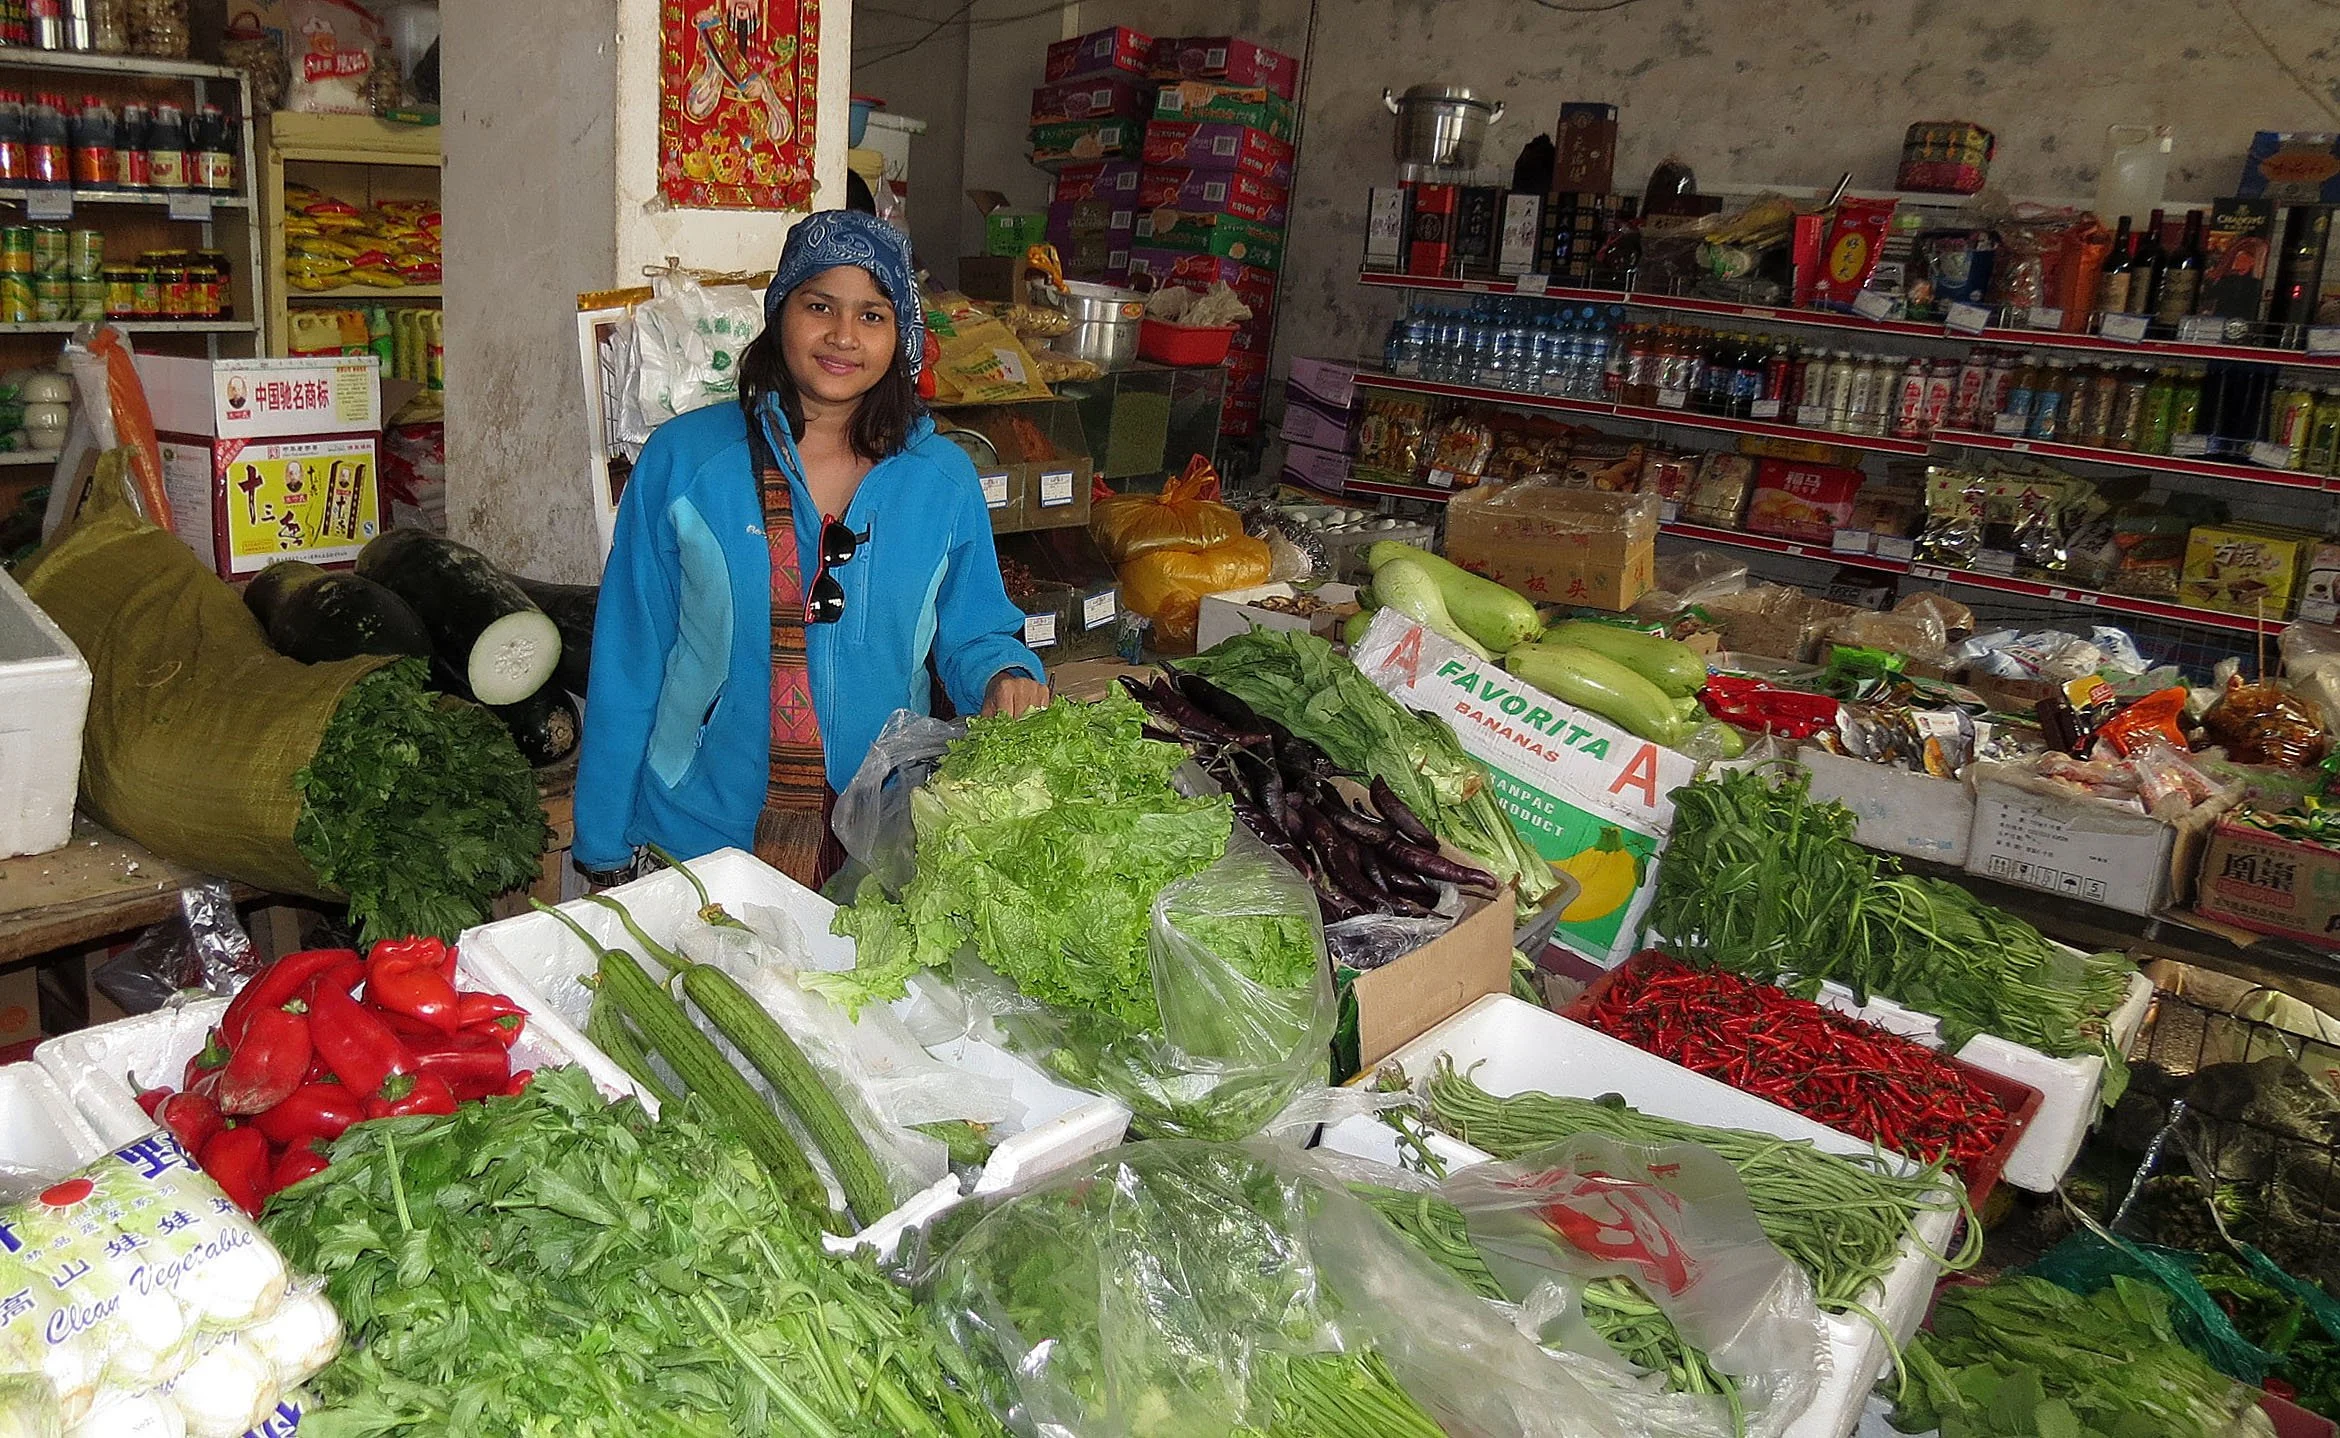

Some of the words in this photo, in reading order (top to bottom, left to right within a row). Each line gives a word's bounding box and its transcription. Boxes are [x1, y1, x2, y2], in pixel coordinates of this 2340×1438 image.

[255, 378, 330, 412] 中国驰名商标
[1381, 625, 1423, 689] A
[1436, 660, 1611, 761] FAVORITA
[1454, 701, 1560, 763] BANANAS
[1608, 744, 1658, 808] A
[1499, 797, 1564, 837] RODUCT
[0, 1196, 236, 1328] 高山娃娃菜
[46, 1294, 121, 1345] Clean
